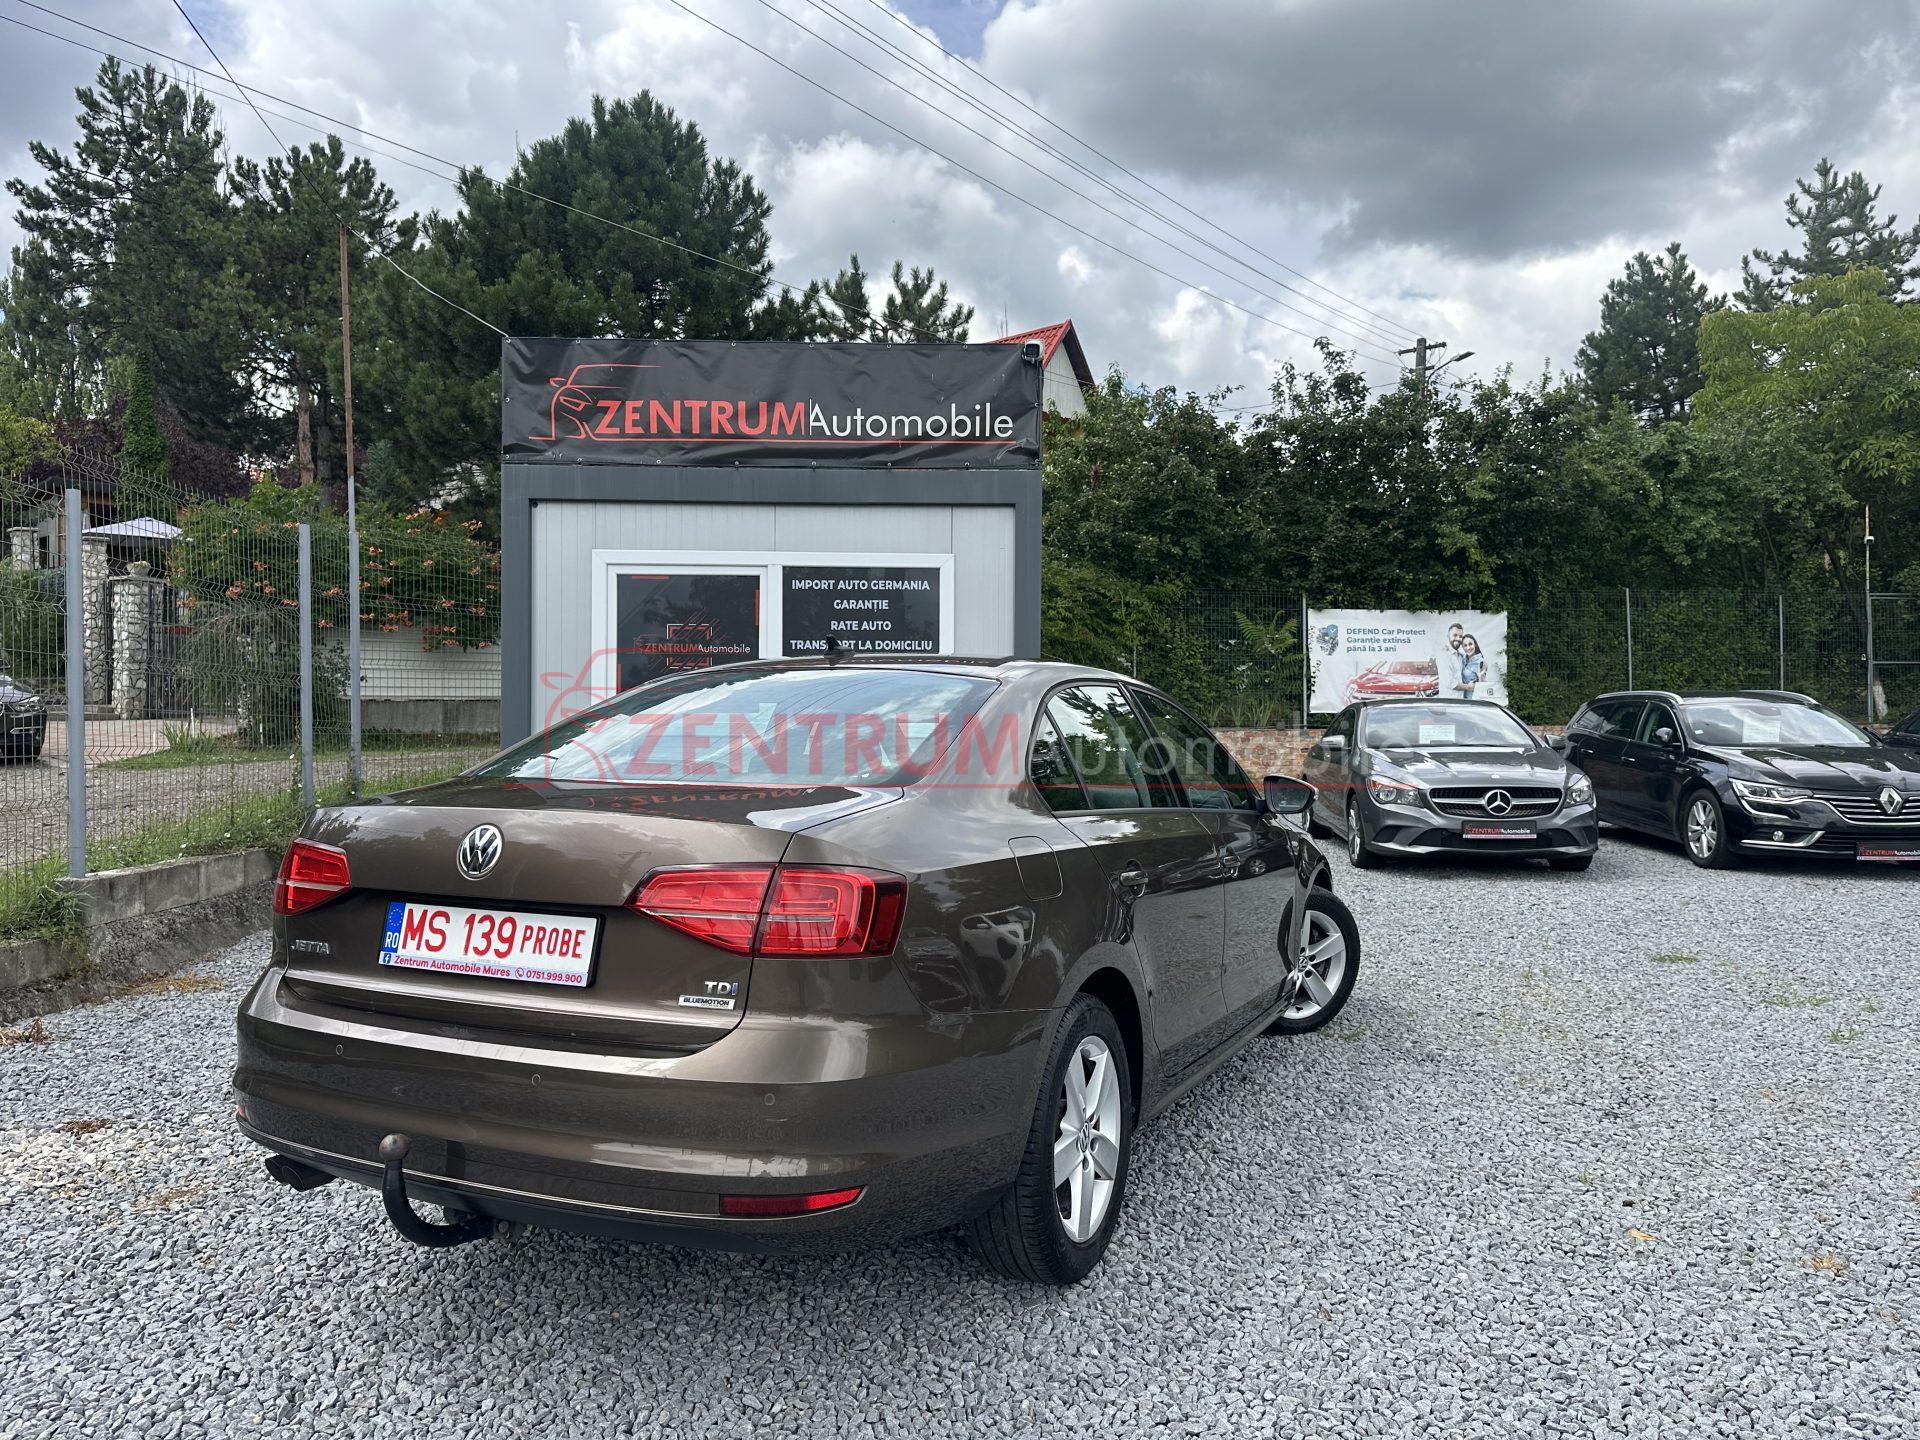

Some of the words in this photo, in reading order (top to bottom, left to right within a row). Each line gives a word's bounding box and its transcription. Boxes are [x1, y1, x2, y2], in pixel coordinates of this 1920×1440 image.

[594, 400, 805, 436] ZENTRUM
[791, 580, 835, 590] IMPORT
[837, 580, 868, 590] AUTO
[870, 580, 930, 590] GERMANIA
[833, 599, 889, 612] GARANȚIE
[830, 620, 859, 631] RATE
[861, 620, 892, 631] AUTO
[1396, 628, 1426, 636] Protect
[790, 640, 856, 650] TRANSRT
[858, 640, 872, 650] LA
[875, 640, 932, 650] DOMICILIU
[1382, 636, 1411, 644] extinsă
[385, 932, 400, 948] RO
[402, 909, 450, 952] MS
[463, 913, 517, 959] 139
[520, 924, 586, 959] PROBE
[290, 939, 330, 955] JETTA
[394, 955, 428, 968] Zentrum
[430, 960, 481, 974] Automobile
[482, 966, 511, 976] Mures
[525, 970, 583, 984] 0751.999.900
[704, 981, 739, 995] TDI
[683, 997, 730, 1006] BLUEMOTION
